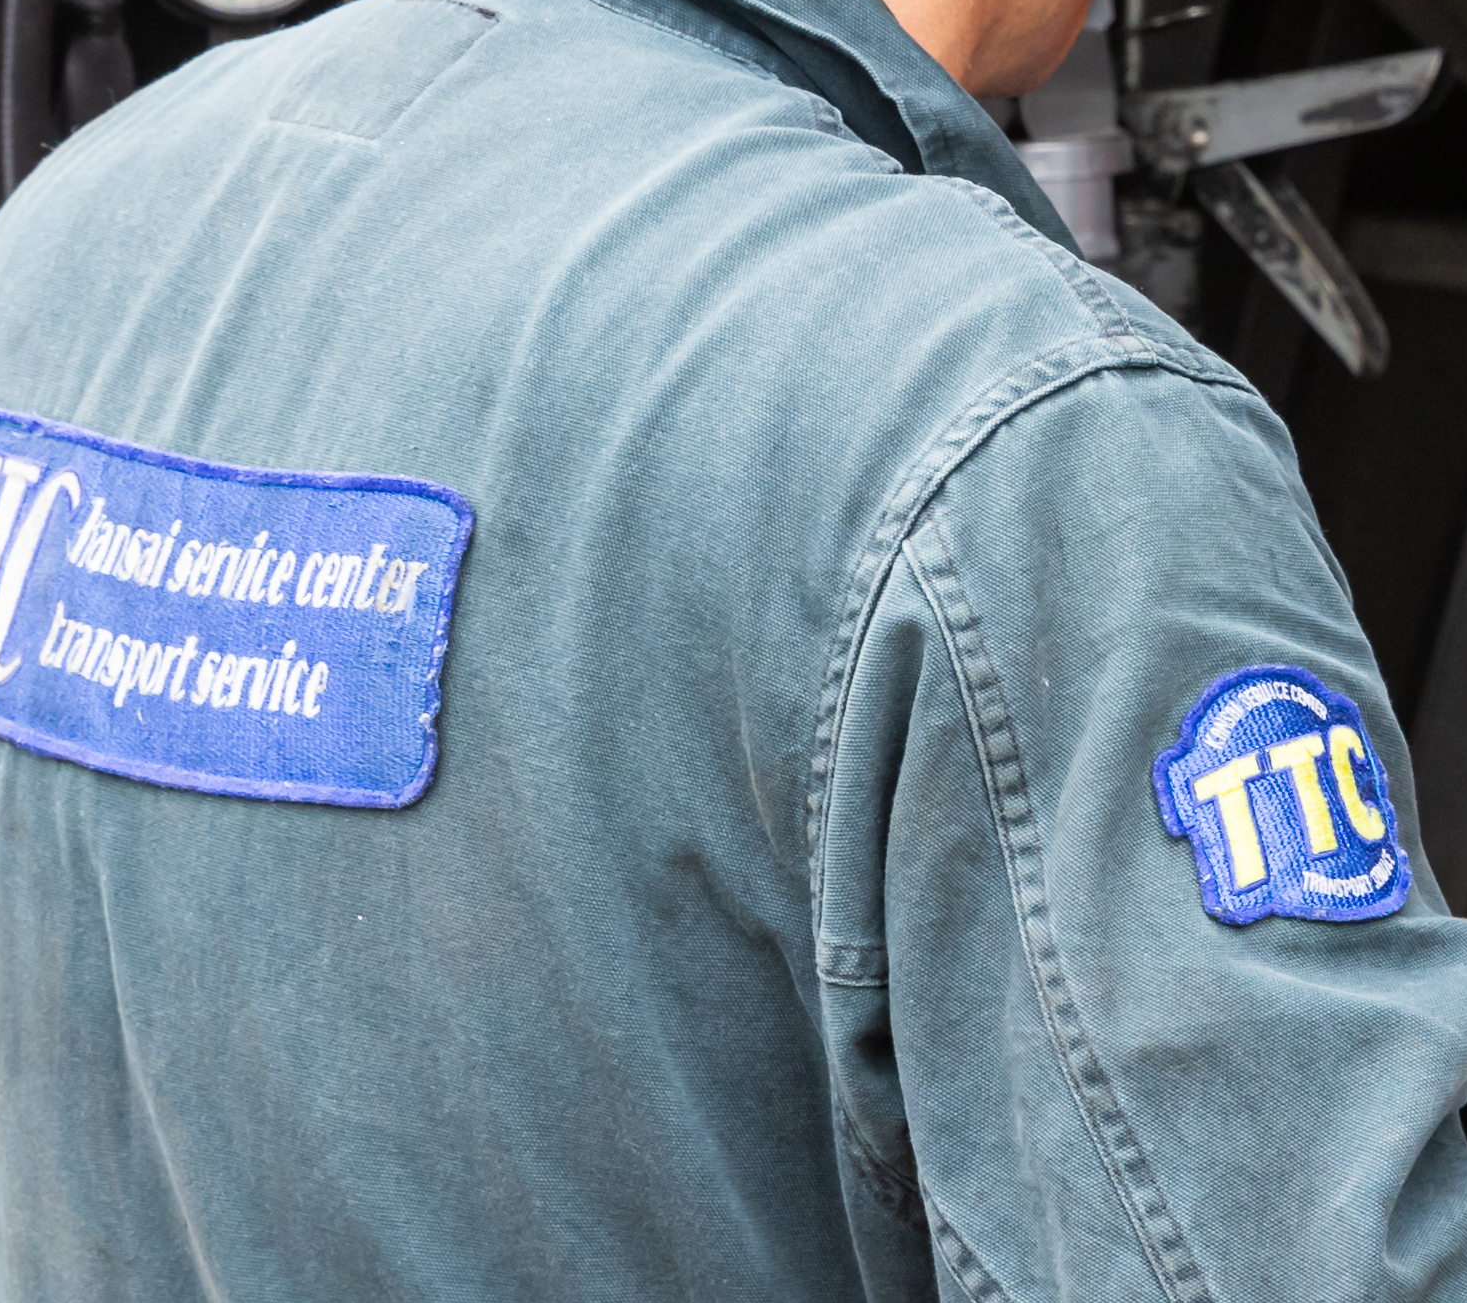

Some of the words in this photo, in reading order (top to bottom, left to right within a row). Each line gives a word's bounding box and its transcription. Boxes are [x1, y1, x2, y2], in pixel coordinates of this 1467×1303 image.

[166, 530, 296, 605] service
[295, 543, 429, 614] center
[40, 600, 199, 708] transport
[191, 639, 330, 719] service
[1237, 681, 1292, 711] SERVICE
[1290, 684, 1328, 721] CENTER
[1193, 724, 1386, 889] TTC
